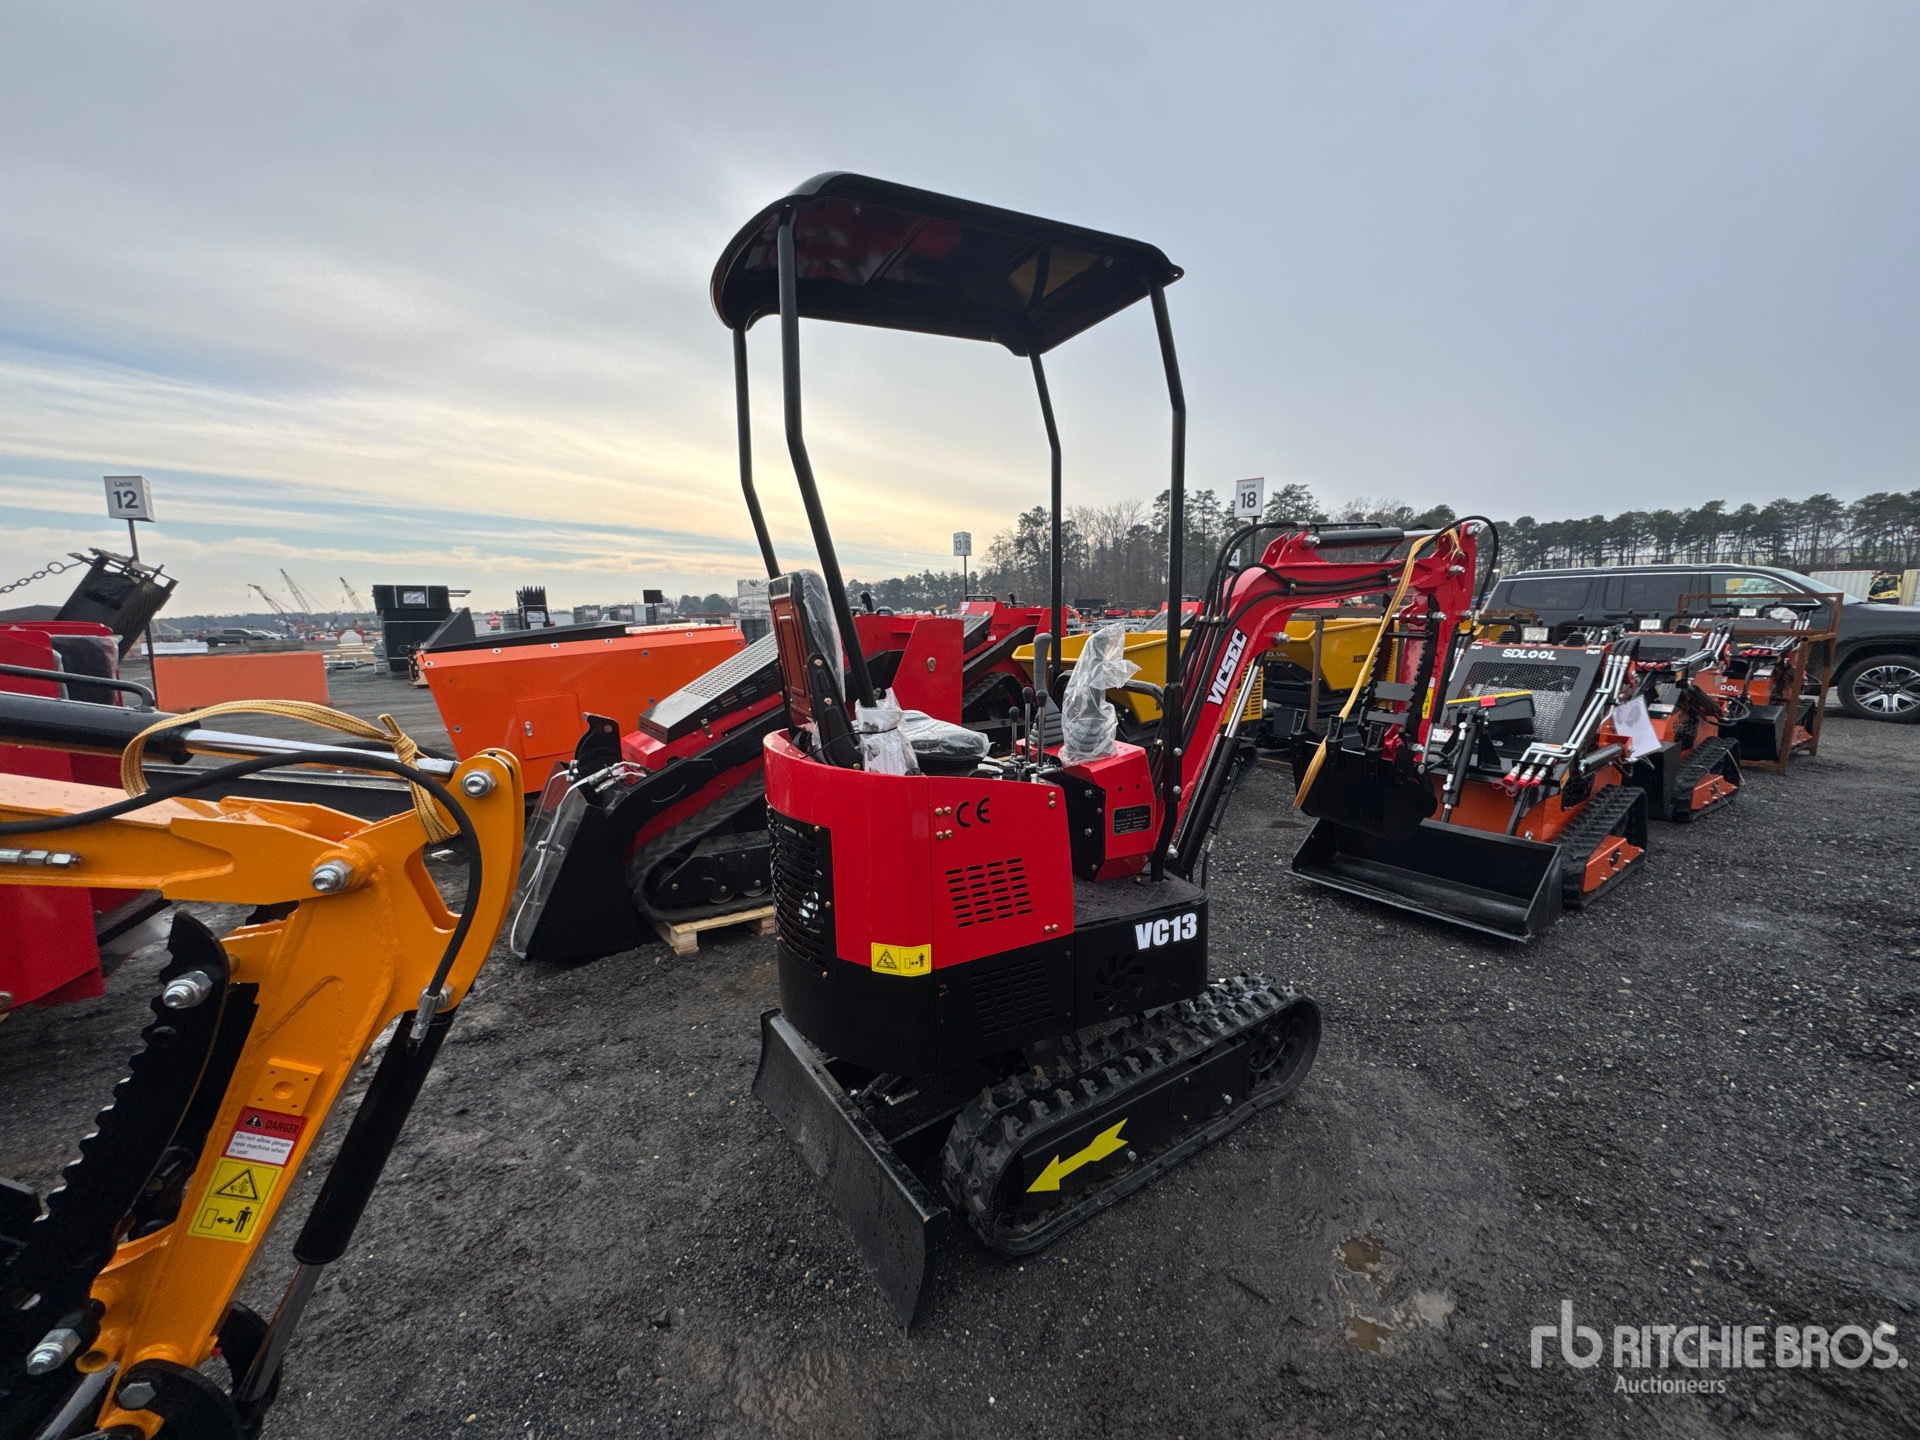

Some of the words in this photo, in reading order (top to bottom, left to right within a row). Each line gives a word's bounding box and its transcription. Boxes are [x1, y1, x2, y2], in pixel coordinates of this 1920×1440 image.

[113, 490, 139, 509] 12
[1241, 491, 1257, 509] 18
[955, 539, 962, 551] 13
[1502, 649, 1557, 661] SDLOOL
[1206, 627, 1248, 706] VICSEC
[956, 797, 991, 828] CE
[1135, 912, 1197, 950] VC13
[265, 1119, 299, 1134] DANGER
[246, 1143, 270, 1151] machine
[271, 1140, 291, 1148] people
